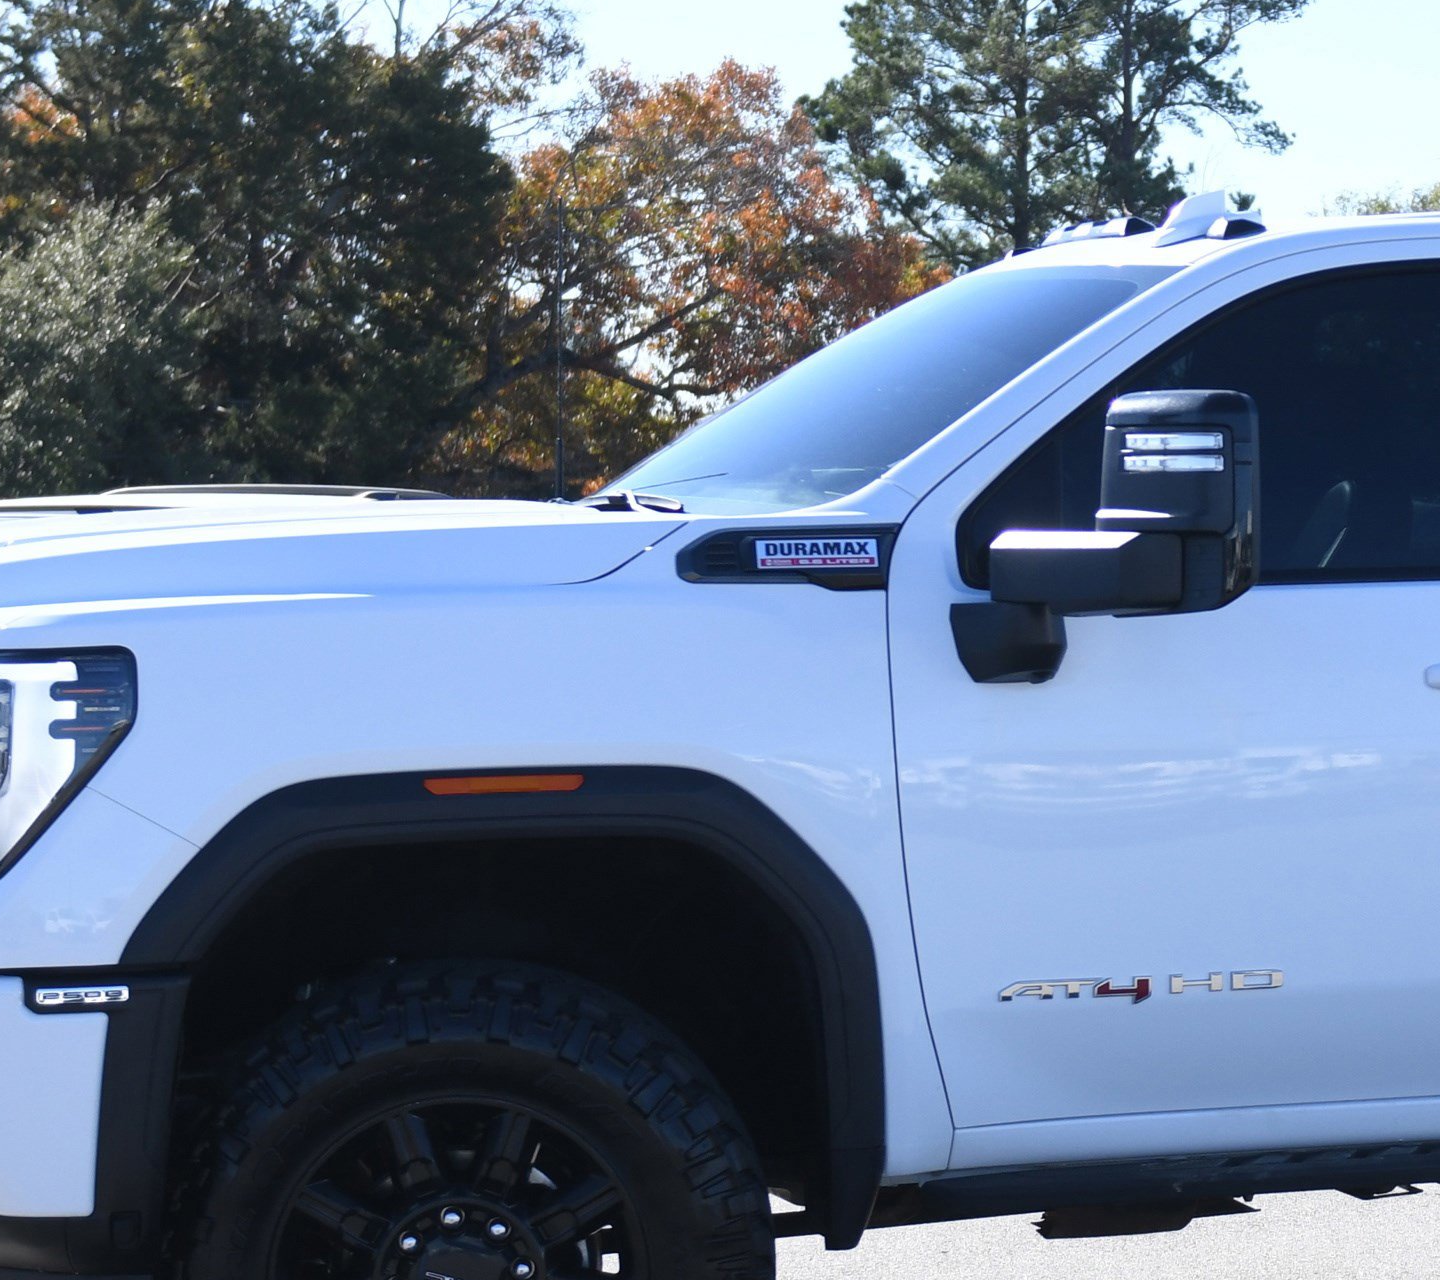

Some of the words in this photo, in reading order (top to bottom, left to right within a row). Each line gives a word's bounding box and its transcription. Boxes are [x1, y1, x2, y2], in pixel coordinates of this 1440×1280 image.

[765, 541, 870, 557] DURAMAX
[997, 975, 1153, 1005] AT4
[1168, 969, 1285, 996] HD
